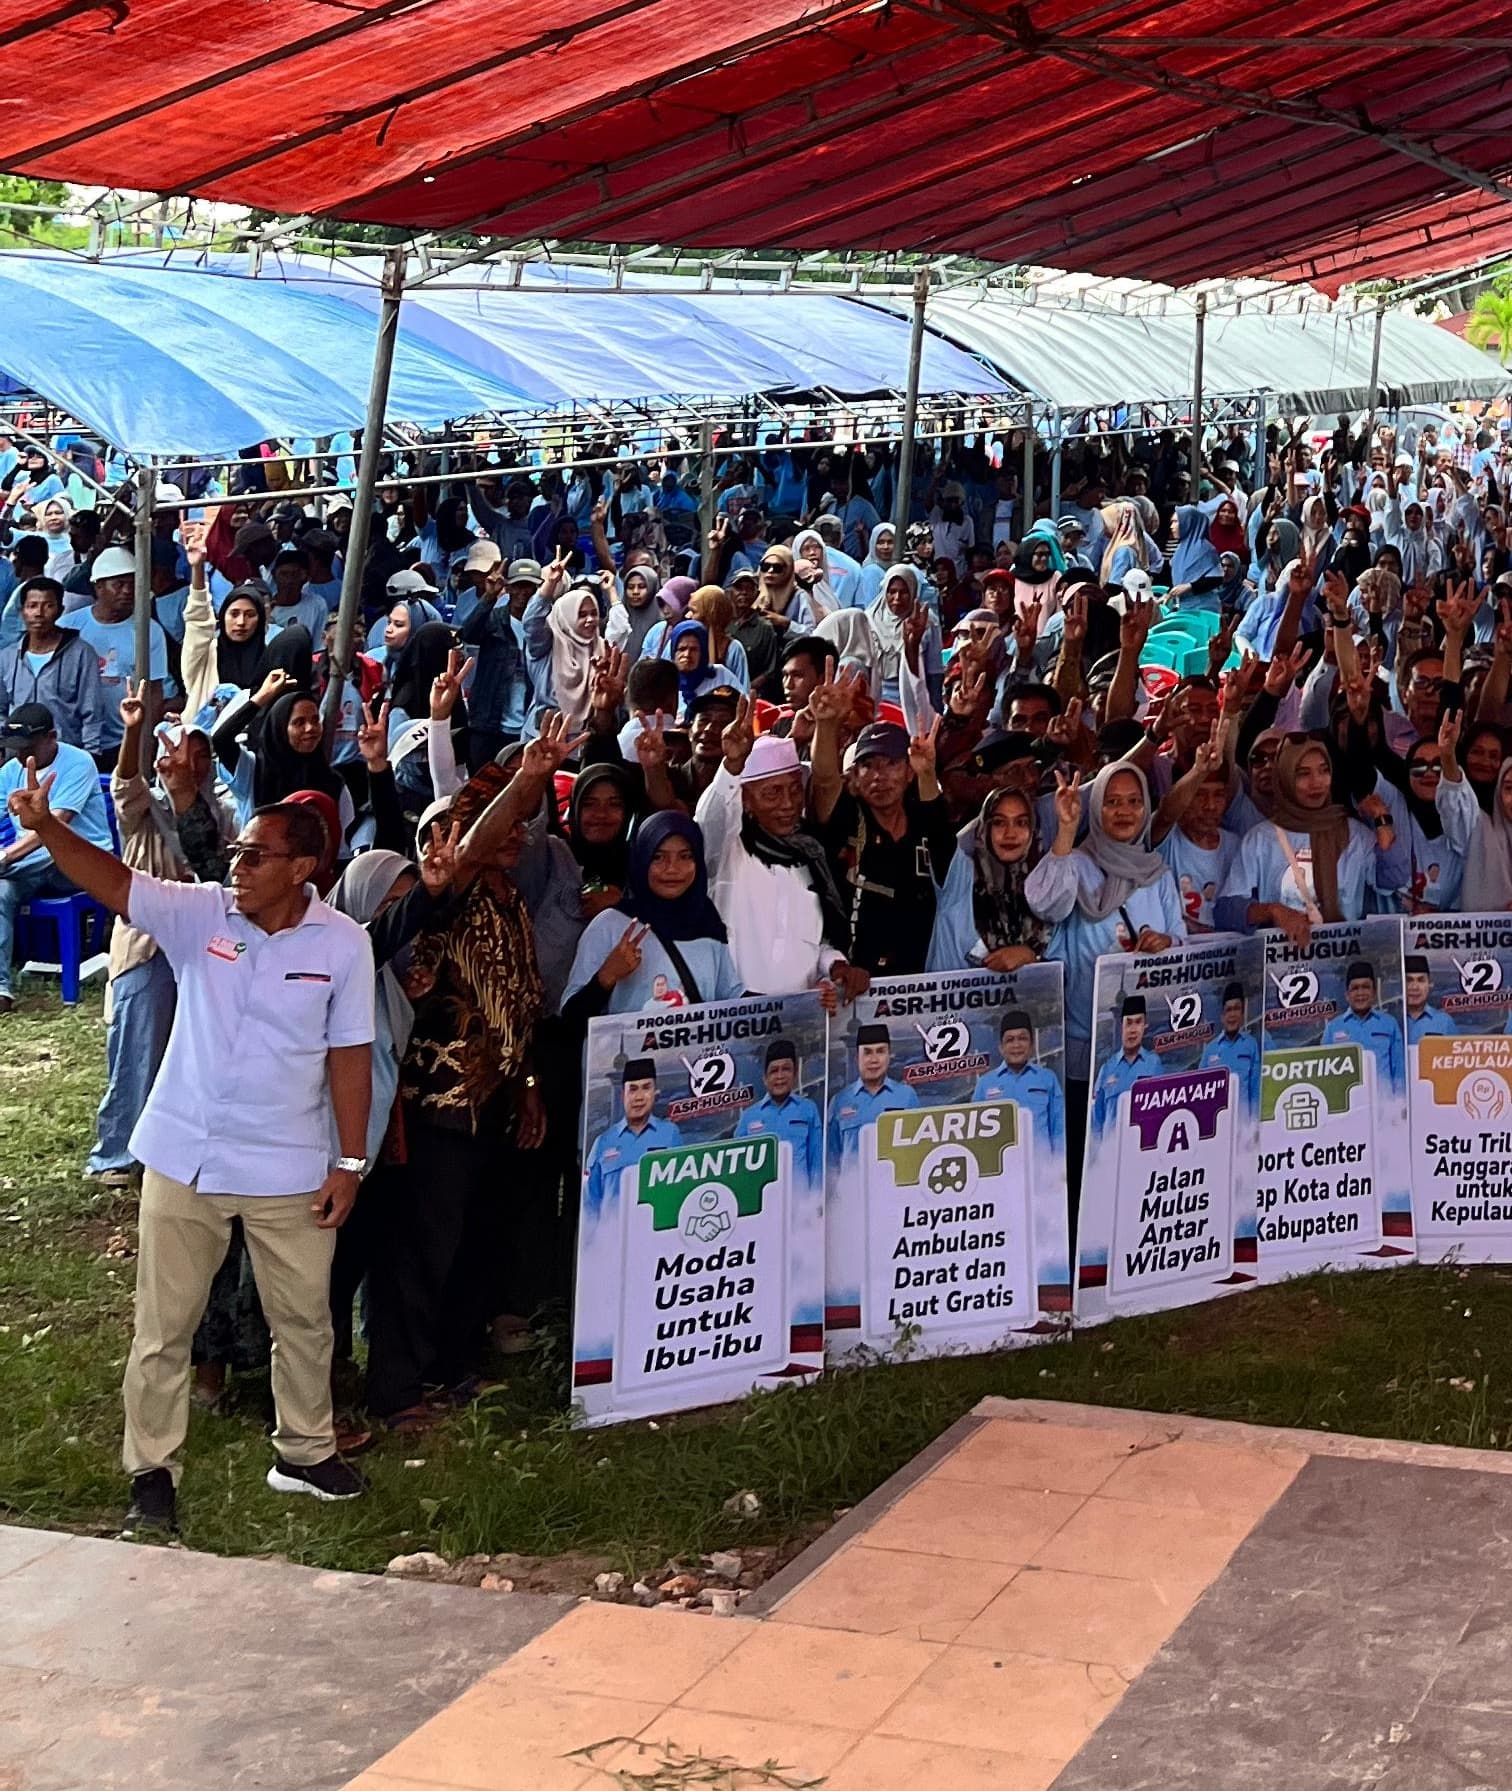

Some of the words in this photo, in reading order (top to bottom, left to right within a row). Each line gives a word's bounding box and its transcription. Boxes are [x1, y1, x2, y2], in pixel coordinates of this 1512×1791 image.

[1409, 920, 1471, 930] PROGRAM
[1134, 953, 1184, 969] PROGRAM
[1265, 940, 1361, 964] R-HUGUA
[869, 982, 937, 997] PROGRAM
[941, 973, 1018, 990] UNGGULAN
[1136, 959, 1235, 990] ASR-HUGUA
[1289, 975, 1311, 1005] 2
[1472, 963, 1494, 992] 2
[636, 1010, 705, 1029] PROGRAM
[708, 1001, 784, 1020] UNGGULAN
[874, 987, 1018, 1018] ASR-HUGUA
[1178, 997, 1196, 1029] 2
[641, 1015, 783, 1052] ASR-HUGUA
[936, 1027, 960, 1059] 2
[1452, 1040, 1510, 1054] SATRIA
[701, 1059, 726, 1094] 2
[908, 1056, 986, 1078] ASR-HUGUA
[1261, 1056, 1355, 1081] PORTIKA
[671, 1089, 750, 1116] ASR-HUGUA
[1134, 1079, 1225, 1111] "JAMA'AH"
[892, 1108, 1001, 1147] LARIS
[1258, 1147, 1295, 1173] ort
[1301, 1141, 1366, 1168] Center
[1425, 1134, 1471, 1154] Satu
[648, 1143, 767, 1187] MANTU
[1144, 1166, 1205, 1196] Jalan
[1256, 1188, 1277, 1213] ap
[1284, 1177, 1330, 1205] Kota
[1336, 1173, 1372, 1199] dan
[903, 1203, 994, 1230] Layanan
[1139, 1191, 1210, 1222] Mulus
[893, 1229, 1005, 1259] Ambulans
[1138, 1217, 1209, 1249] Antar
[655, 1241, 756, 1281] Modal
[1125, 1236, 1221, 1277] Wilayah
[894, 1262, 958, 1289] Darat
[965, 1258, 1006, 1282] dan
[655, 1276, 755, 1310] Usaha
[888, 1295, 939, 1320] Laut
[947, 1284, 1013, 1313] Gratis
[657, 1302, 754, 1340] untuk
[643, 1333, 762, 1373] Ibu-ibu
